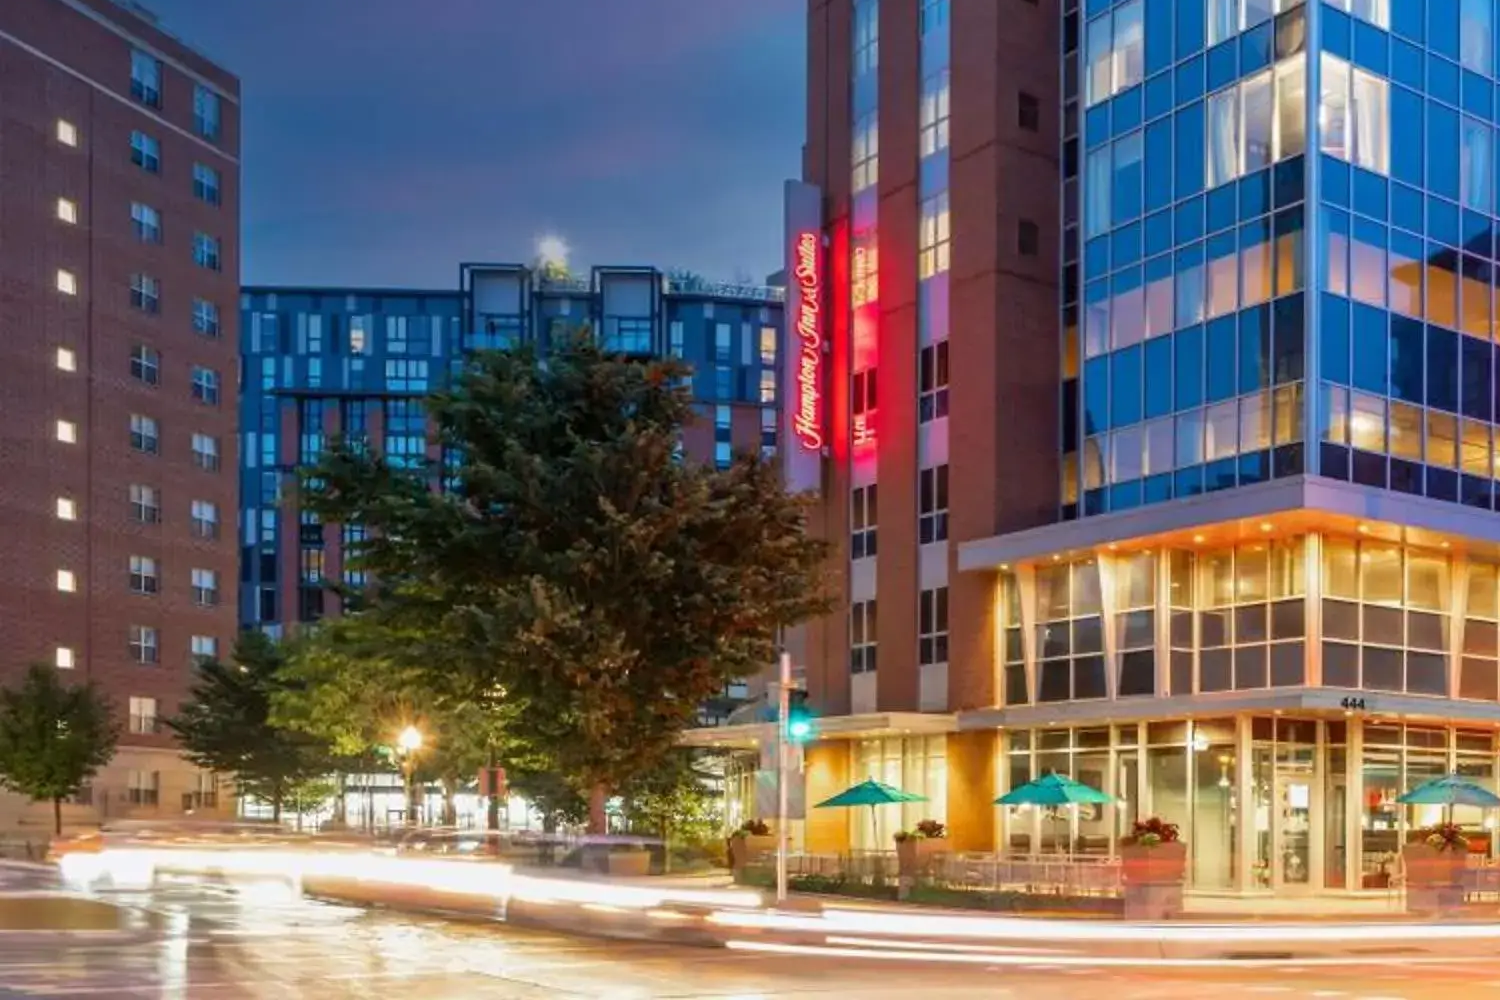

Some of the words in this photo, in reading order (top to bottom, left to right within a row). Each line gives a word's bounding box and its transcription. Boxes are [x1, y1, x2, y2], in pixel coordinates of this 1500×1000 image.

[795, 233, 817, 286] Suites
[797, 301, 820, 349] Inn
[795, 347, 821, 450] Hampton
[1340, 696, 1366, 710] 444
